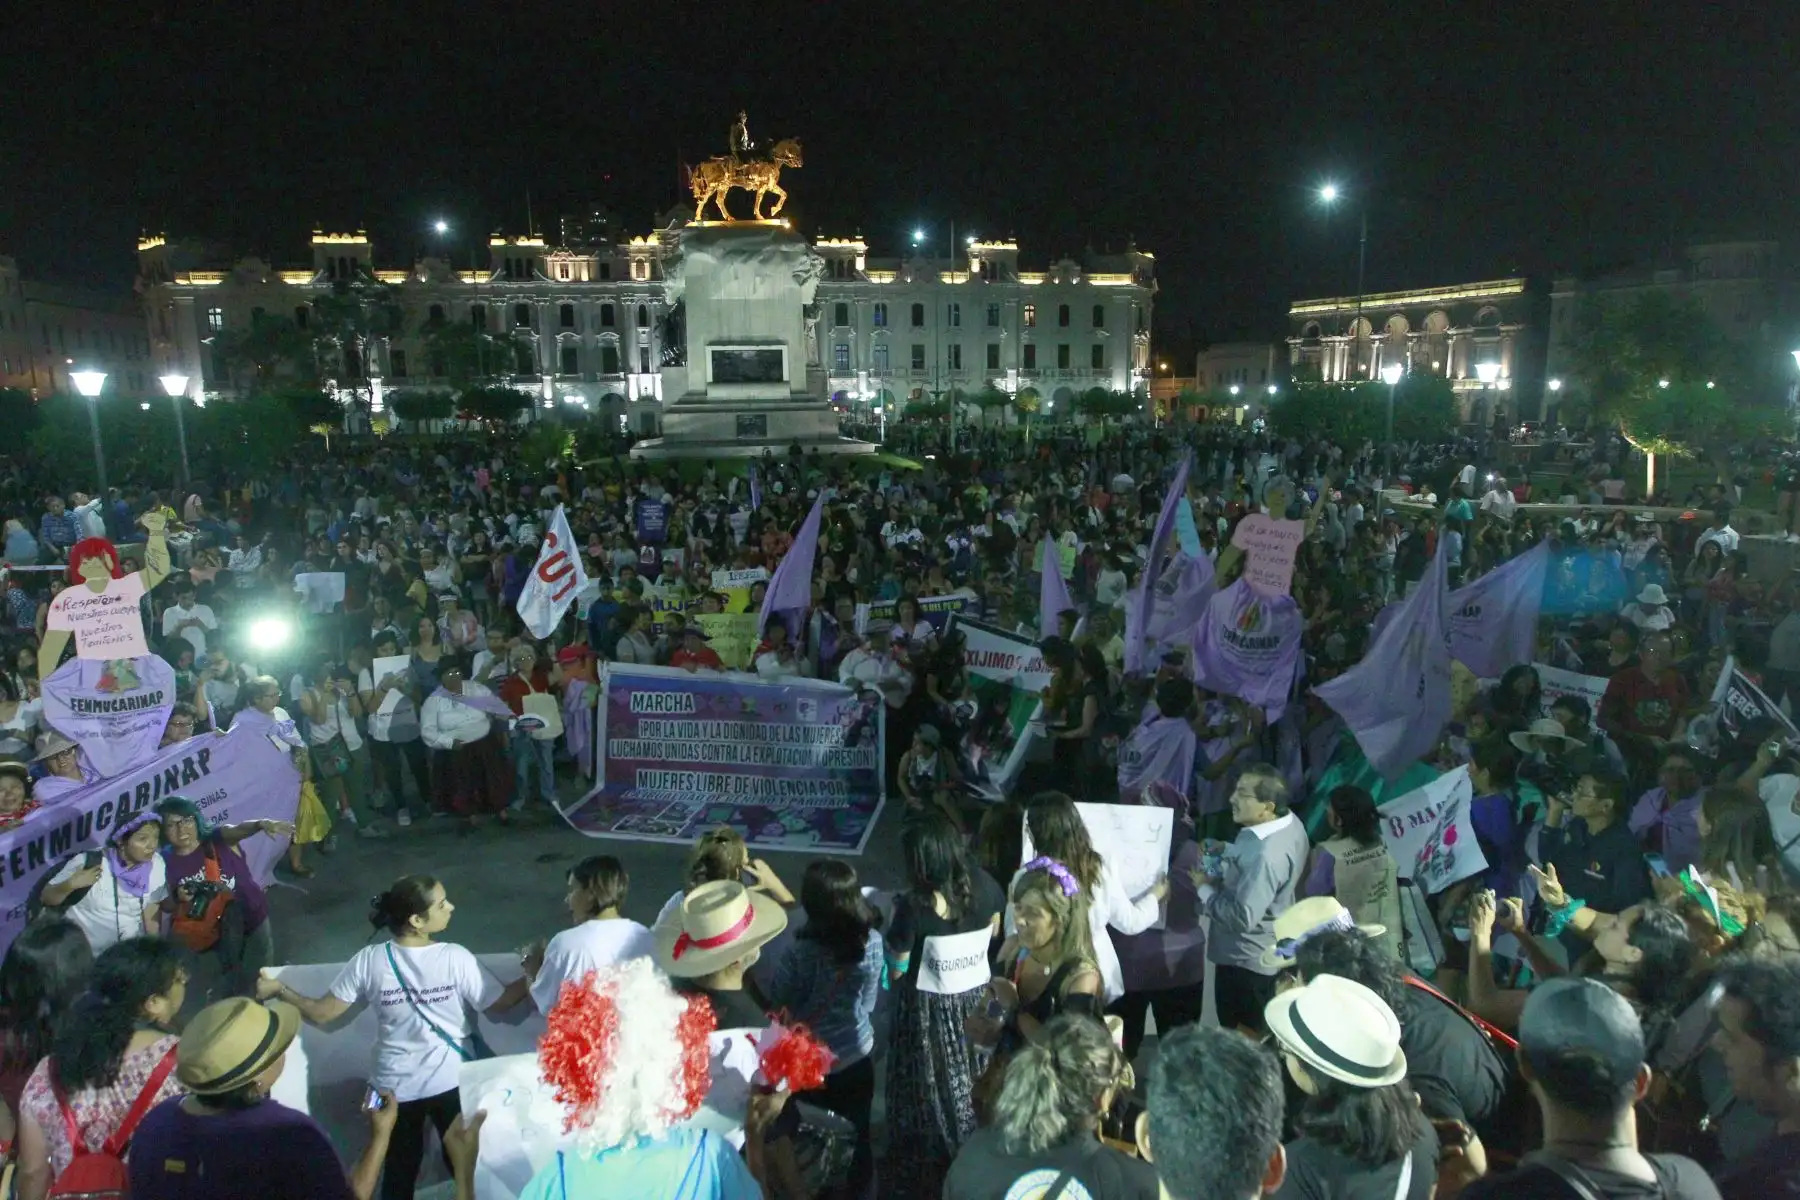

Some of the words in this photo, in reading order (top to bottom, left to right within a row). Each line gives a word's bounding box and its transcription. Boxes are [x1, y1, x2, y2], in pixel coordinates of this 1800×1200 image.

[70, 690, 163, 714] FENMUCARINAP
[632, 693, 694, 712] MARCHA
[664, 721, 675, 738] LA
[677, 722, 700, 738] VIDA
[702, 722, 708, 738] Y
[710, 722, 721, 739] LA
[724, 722, 768, 742] DIGNIDAD
[769, 725, 783, 742] DE
[783, 726, 800, 743] LAS
[611, 740, 662, 758] LUCHAMOS
[664, 743, 700, 760] UNIDAS
[702, 744, 738, 762] CONTRA
[740, 746, 751, 762] LA
[638, 771, 694, 791] MUJERES
[696, 772, 731, 793] LIBRE
[734, 776, 750, 793] DE
[752, 778, 818, 796] VIOLENCIA
[820, 780, 845, 796] POR
[0, 747, 211, 888] FENMUCARINAP
